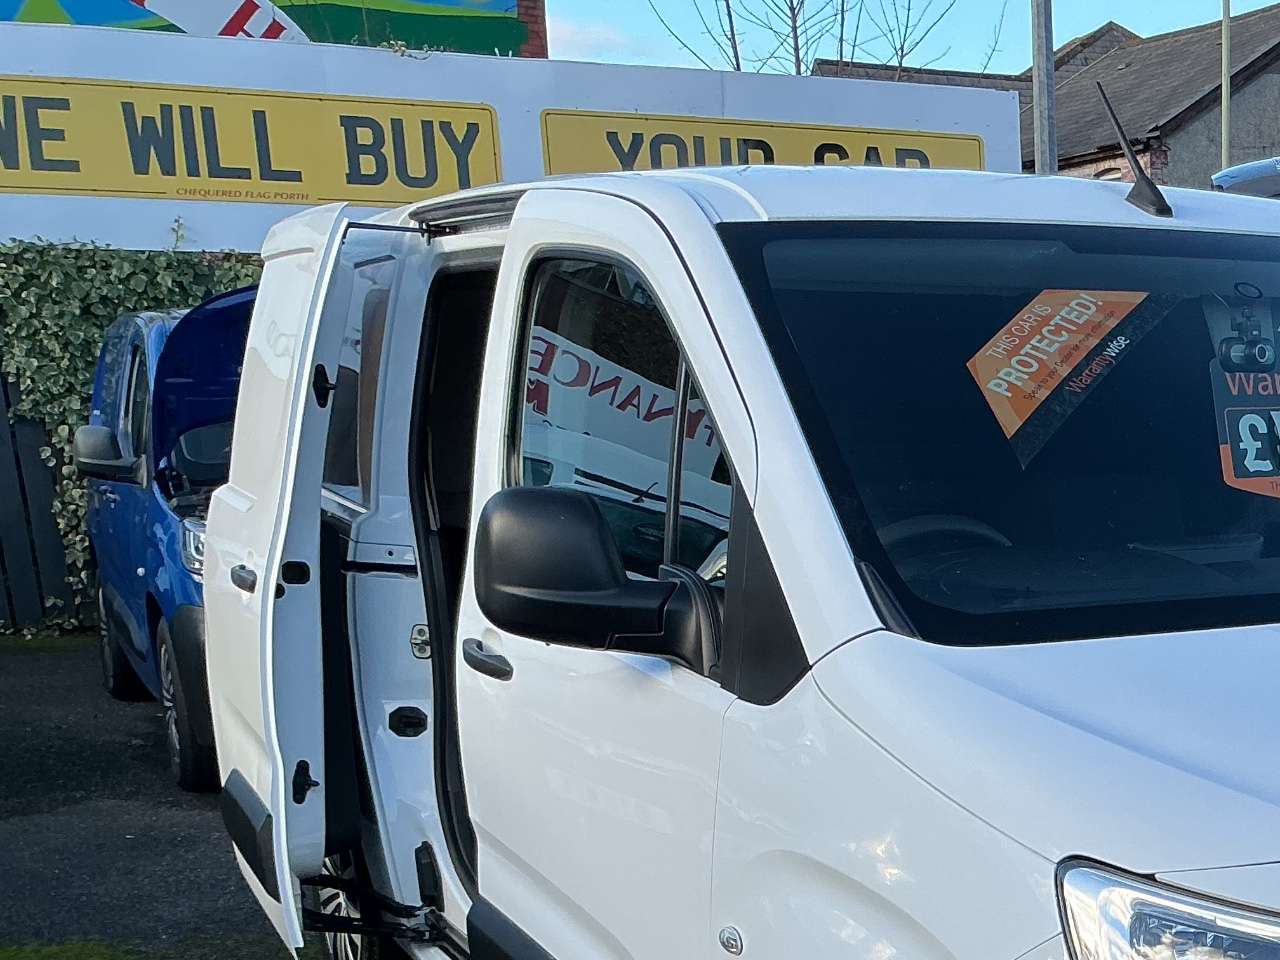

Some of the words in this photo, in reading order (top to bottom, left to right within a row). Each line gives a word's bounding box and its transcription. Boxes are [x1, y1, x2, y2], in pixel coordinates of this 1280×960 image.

[121, 101, 303, 183] WILL
[340, 115, 480, 190] BUY
[176, 187, 242, 198] CHEQUERED
[245, 190, 272, 199] FLAG
[274, 192, 309, 200] PORTH
[985, 293, 1104, 398] PROTECTED!
[986, 334, 1020, 360] THIS
[1014, 313, 1043, 341] CAR
[1033, 304, 1052, 322] IS
[1064, 335, 1131, 394] Warrantywise
